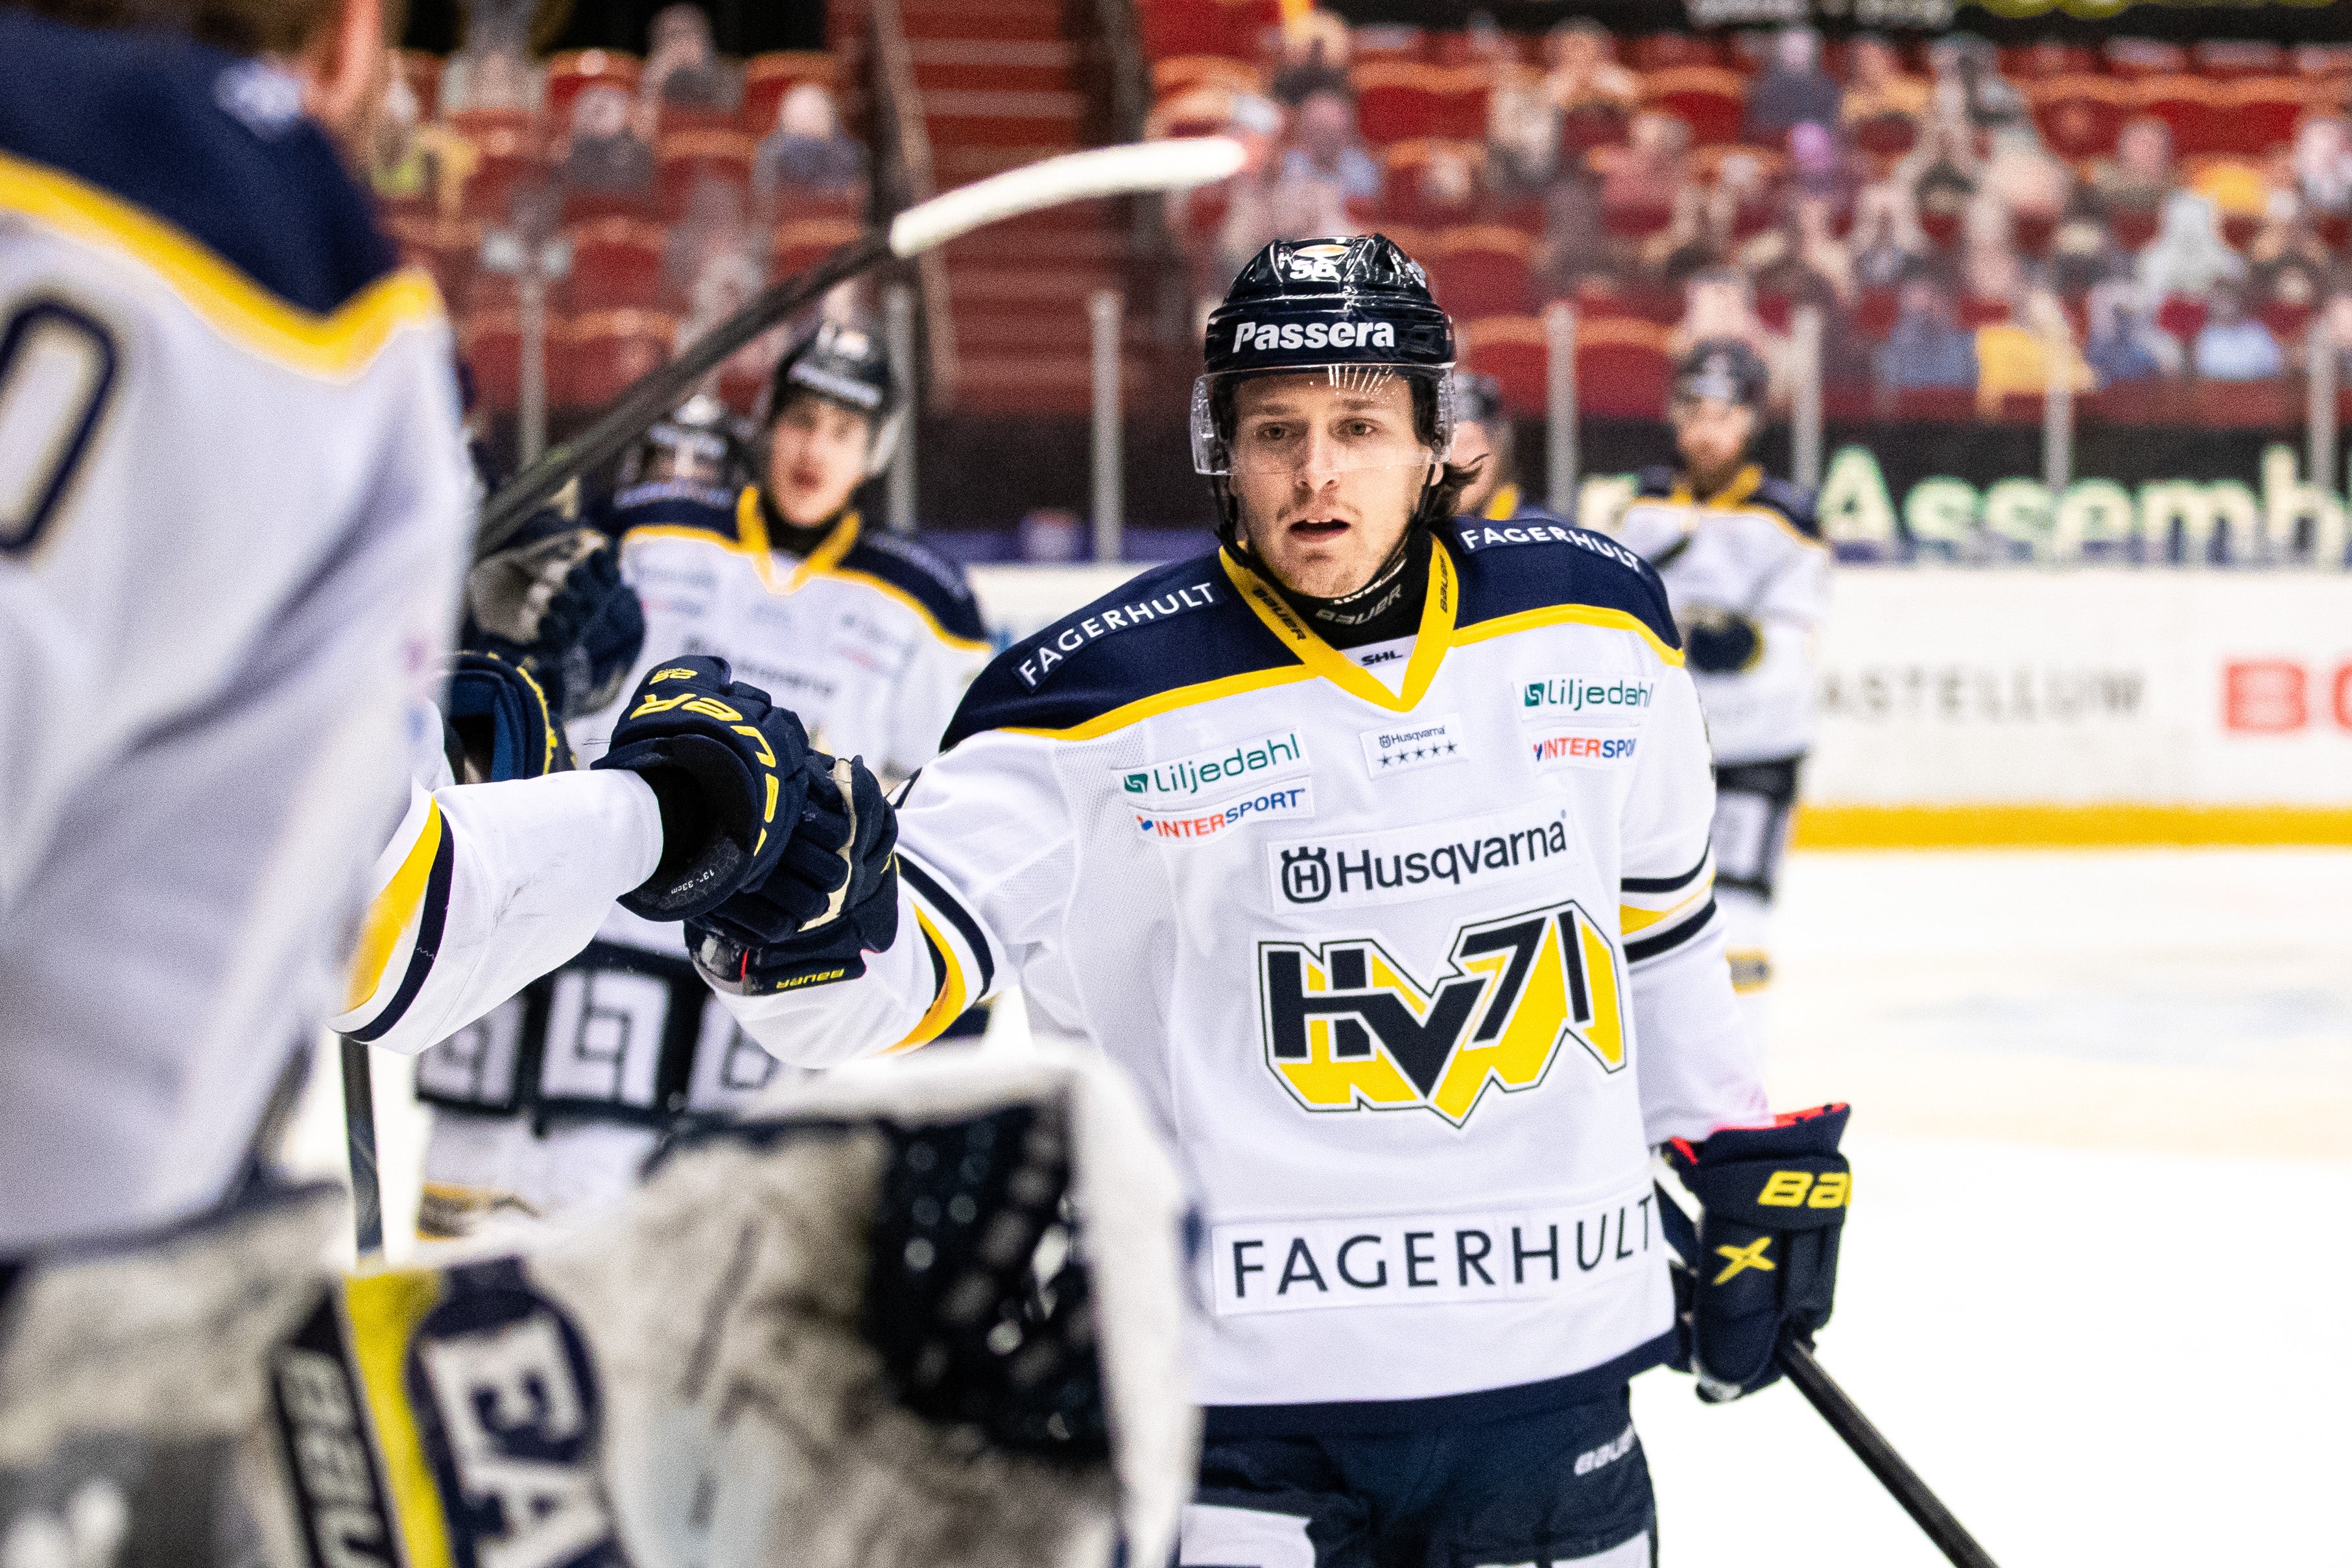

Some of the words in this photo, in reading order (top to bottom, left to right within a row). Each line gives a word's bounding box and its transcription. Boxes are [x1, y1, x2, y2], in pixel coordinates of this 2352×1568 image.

[1231, 321, 1395, 354] Passera
[1818, 444, 2352, 565] Assemb
[1460, 526, 1640, 573] FAGERHULT
[1019, 582, 1215, 686] FAGERHULT
[1360, 650, 1403, 667] SHL
[1547, 679, 1654, 711] Liljedahl
[1391, 726, 1445, 744] Husqvarna
[1543, 737, 1637, 759] INTERSPO
[629, 693, 779, 856] AUER
[1154, 733, 1300, 794] Liljedahl
[1155, 788, 1305, 838] INTERSPORT
[1337, 820, 1567, 894] Husqvarna
[1265, 908, 1602, 1104] HV71
[1757, 1170, 1853, 1209] BA
[1231, 1194, 1654, 1298] FAGERHULT
